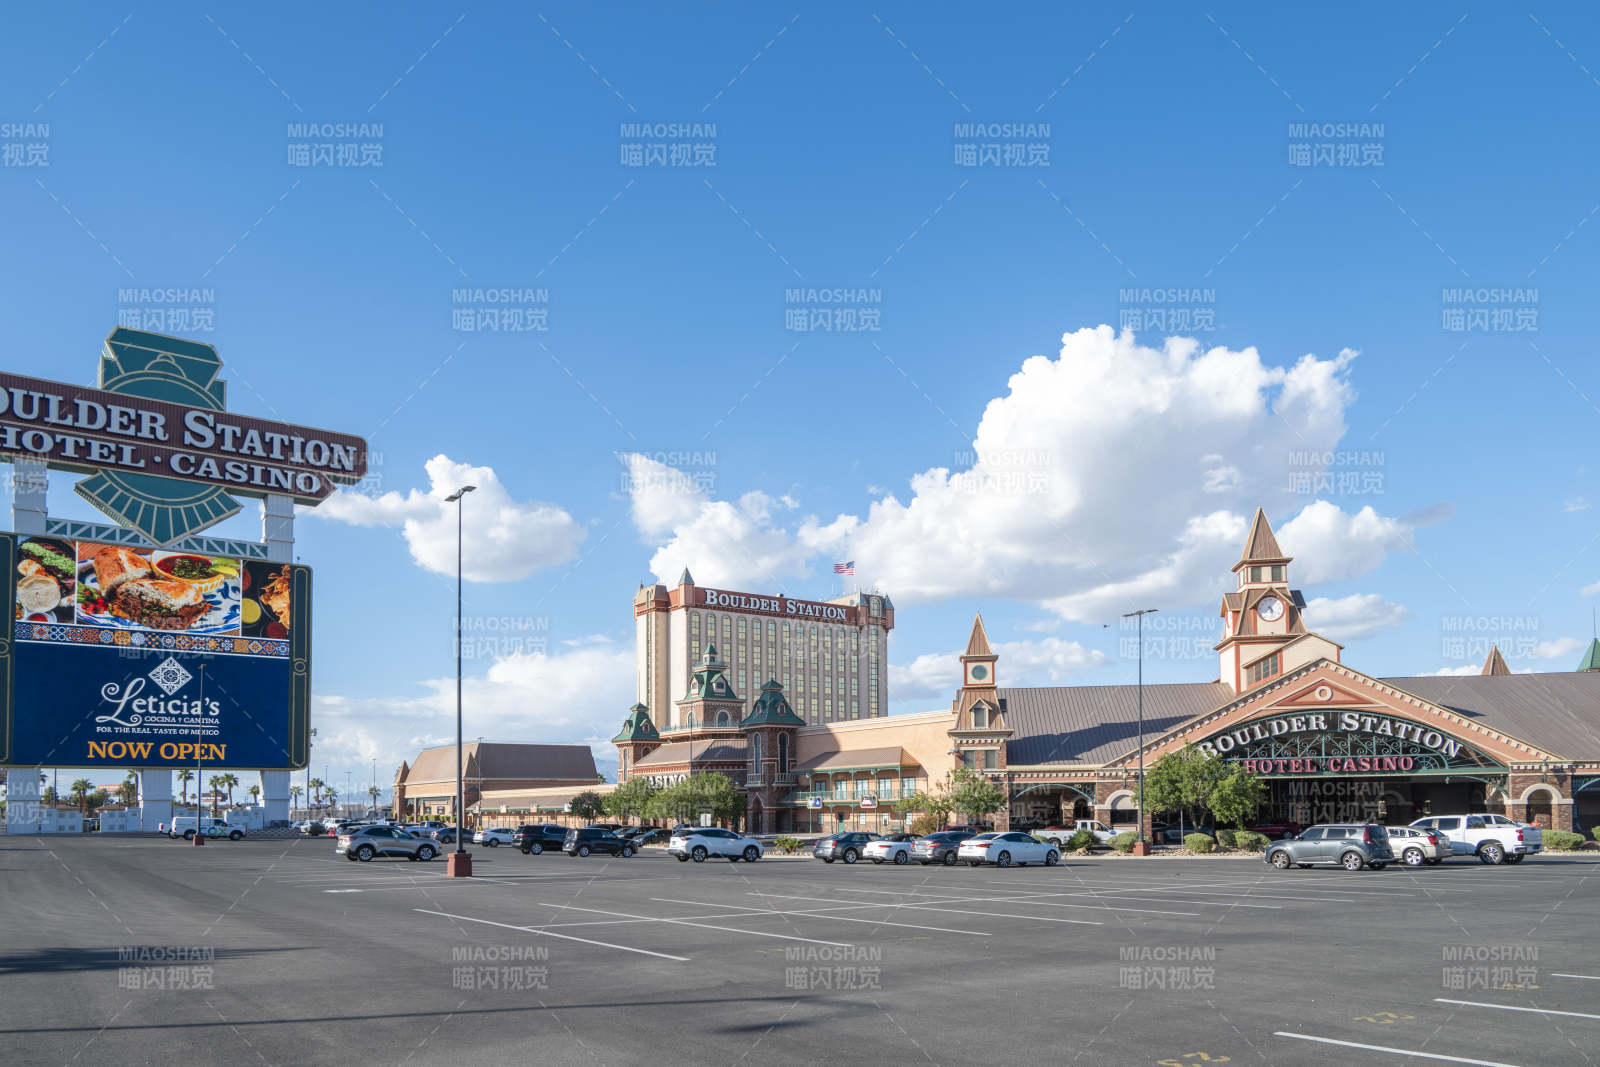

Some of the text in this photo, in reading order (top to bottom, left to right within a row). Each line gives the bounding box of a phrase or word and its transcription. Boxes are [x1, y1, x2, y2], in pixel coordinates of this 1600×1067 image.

[183, 410, 357, 472] STATION
[169, 453, 320, 494] CASINO
[704, 589, 847, 621] BOULDER STATION
[95, 677, 220, 727] Leticia's
[144, 716, 177, 724] COCINA
[183, 717, 220, 725] CANTINA
[1195, 712, 1464, 761] BOULDER STATION
[87, 741, 227, 760] NOW OPEN
[1243, 755, 1414, 775] HOTEL CASINO
[642, 774, 687, 789] ASINO
